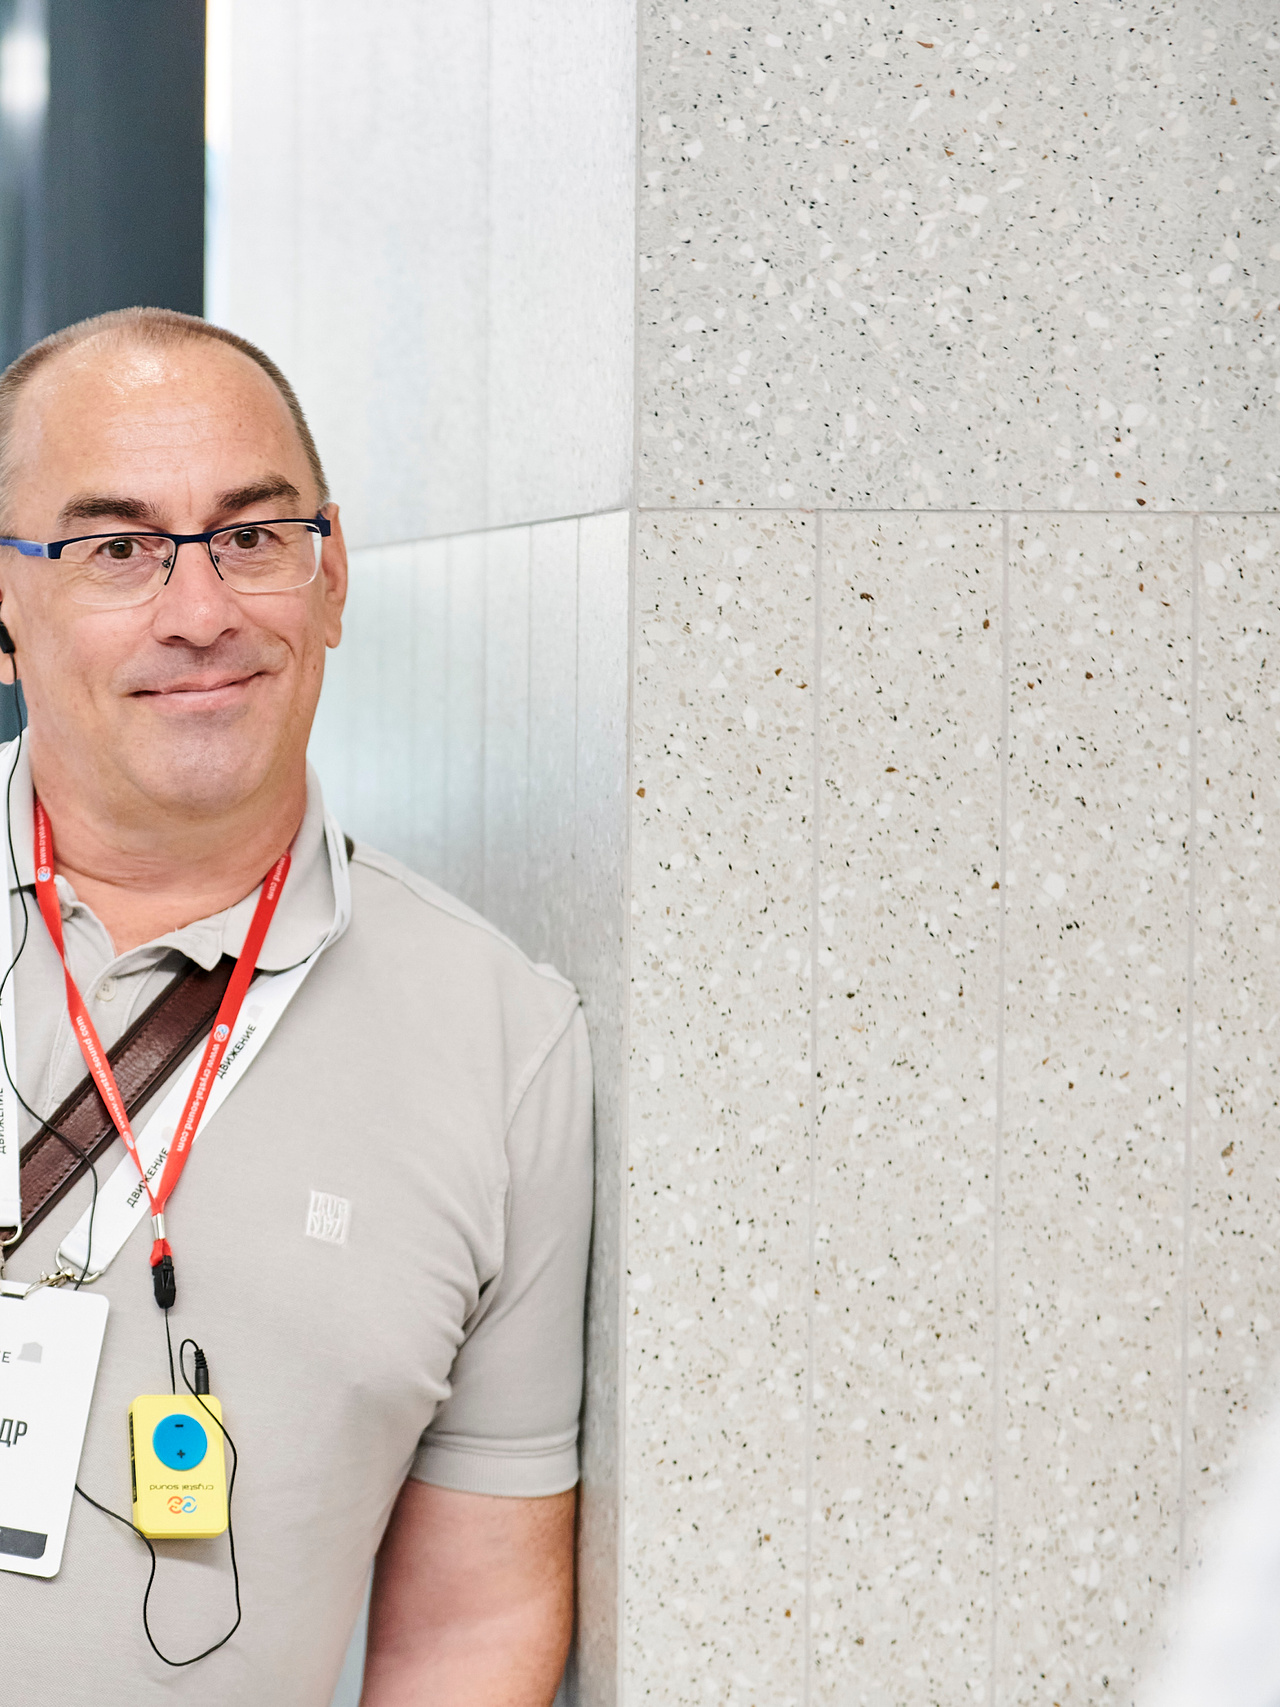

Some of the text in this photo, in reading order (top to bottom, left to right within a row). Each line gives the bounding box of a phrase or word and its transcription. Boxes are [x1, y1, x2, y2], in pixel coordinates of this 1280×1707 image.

[75, 1015, 126, 1129] www.crystal-sound.com
[176, 1043, 220, 1152] www.crystal-sound.com
[182, 1483, 214, 1491] crystal
